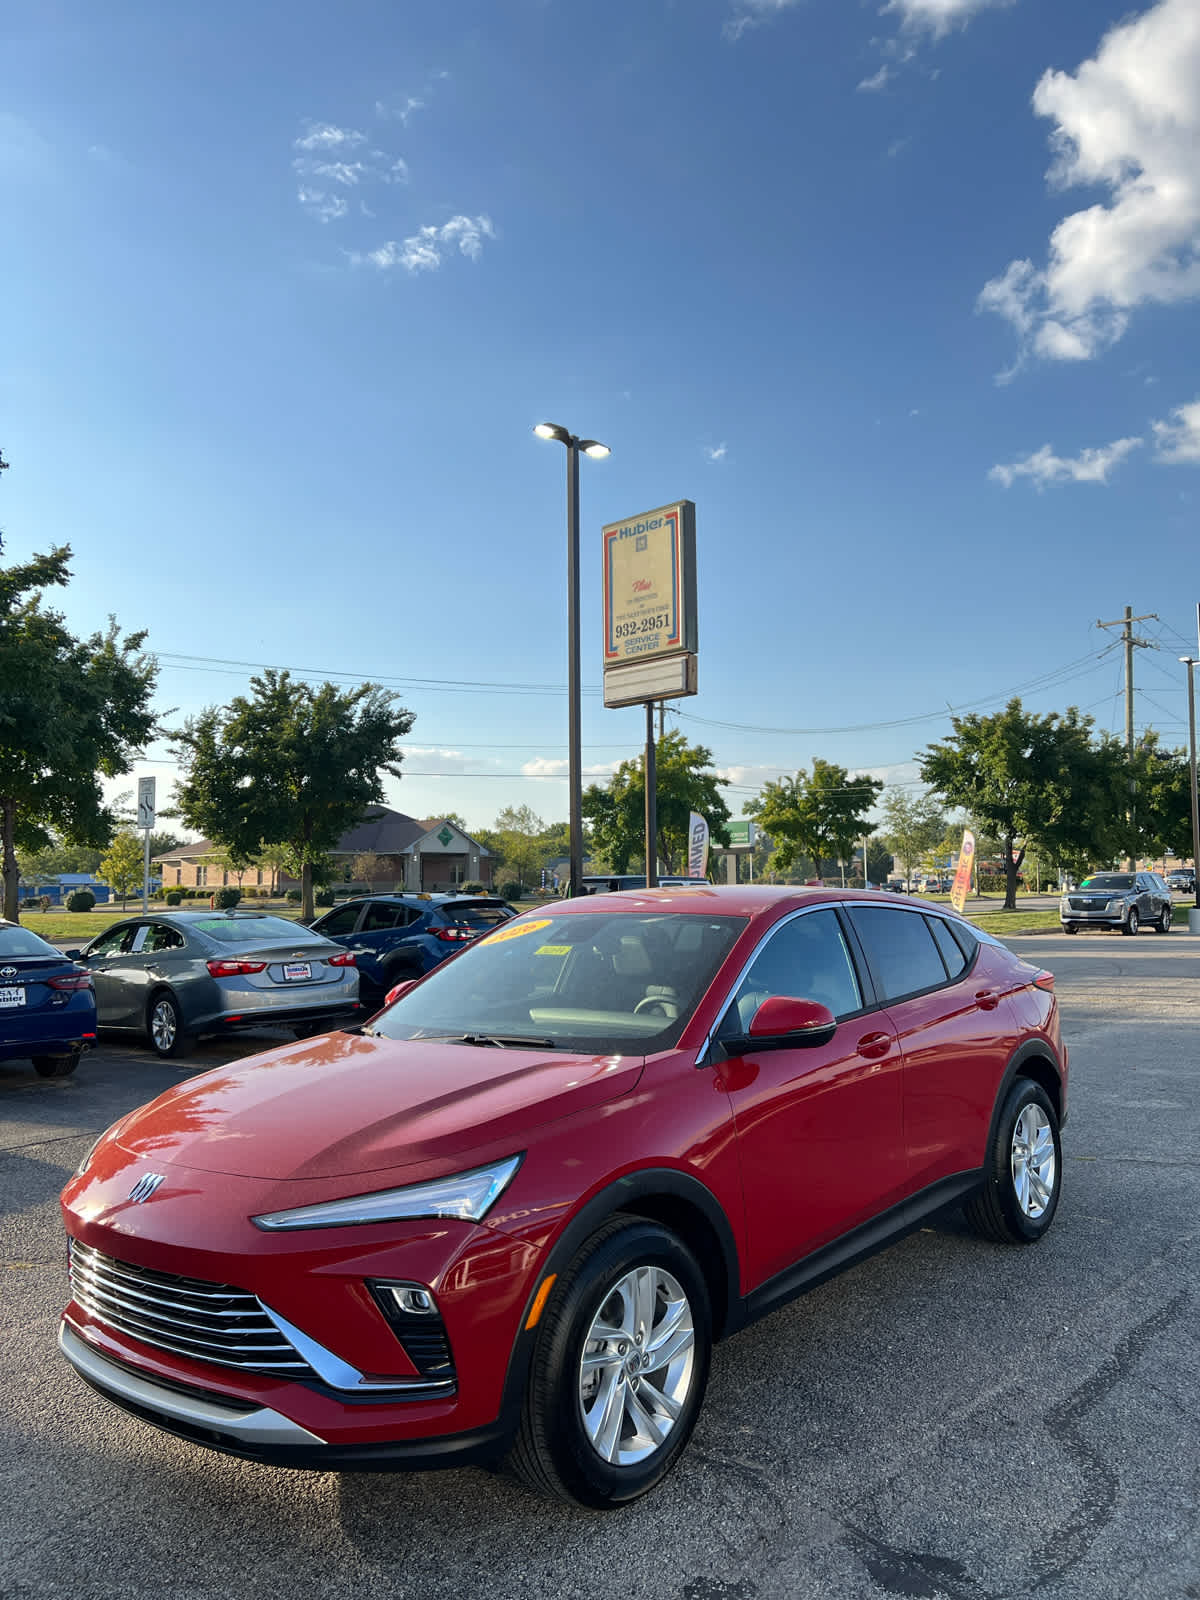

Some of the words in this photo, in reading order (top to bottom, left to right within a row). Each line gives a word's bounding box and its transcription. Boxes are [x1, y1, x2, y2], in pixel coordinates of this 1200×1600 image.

[619, 517, 665, 539] Hubler
[616, 614, 670, 639] 932-2951
[624, 633, 660, 647] SERVICE
[625, 641, 660, 655] CENTER
